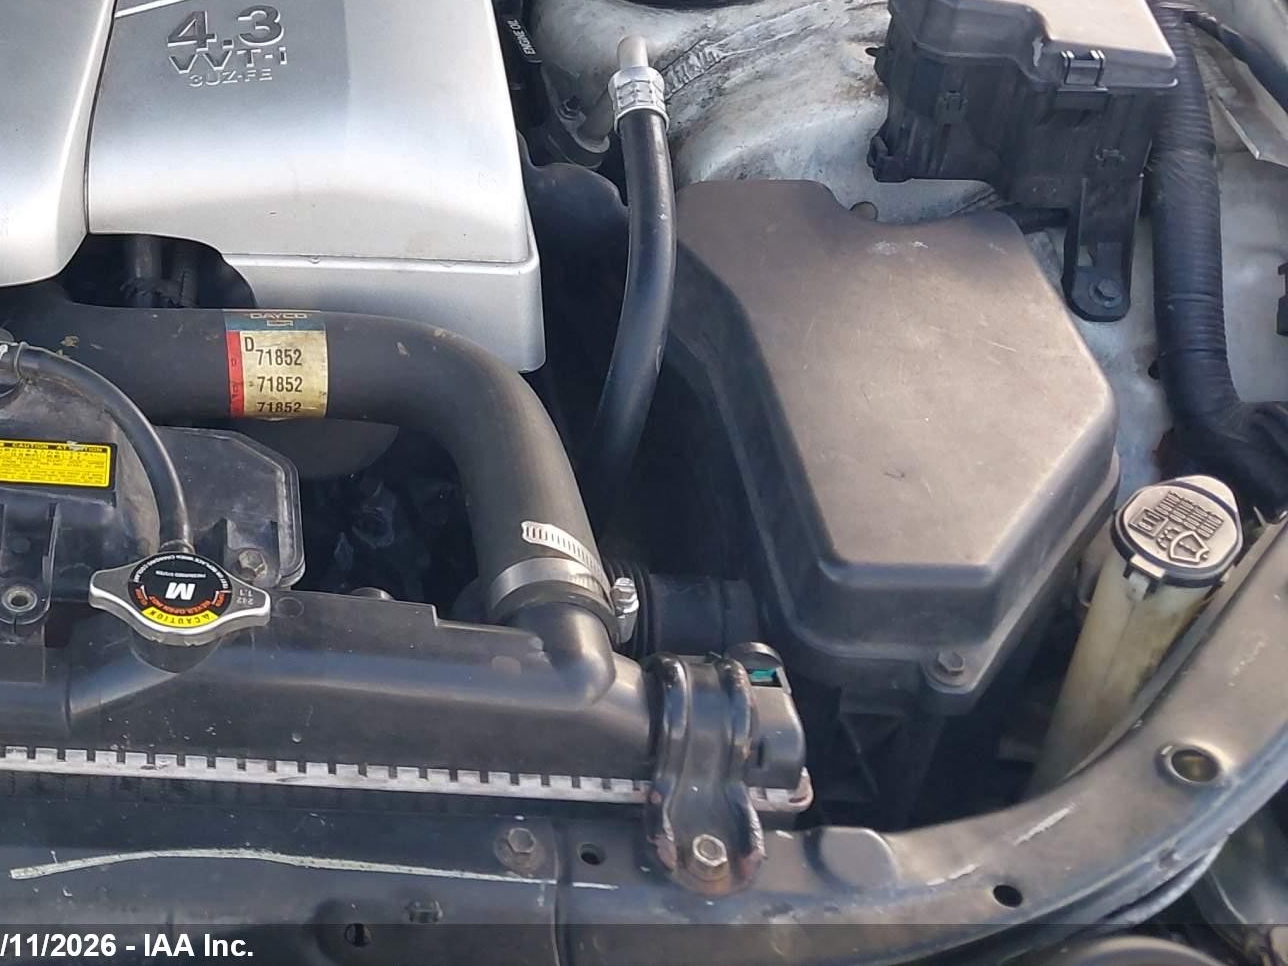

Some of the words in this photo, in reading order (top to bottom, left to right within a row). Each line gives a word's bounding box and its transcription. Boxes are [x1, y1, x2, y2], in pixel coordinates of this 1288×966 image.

[168, 4, 285, 52] 4.3
[507, 19, 522, 30] OIL
[513, 30, 536, 55] ENGINE
[188, 68, 273, 88] 3UZ-FE
[244, 336, 255, 352] D
[256, 349, 303, 366] 71852
[256, 376, 303, 393] 71852
[256, 401, 302, 413] 71852
[164, 581, 196, 601] M
[149, 609, 202, 625] CAUTION
